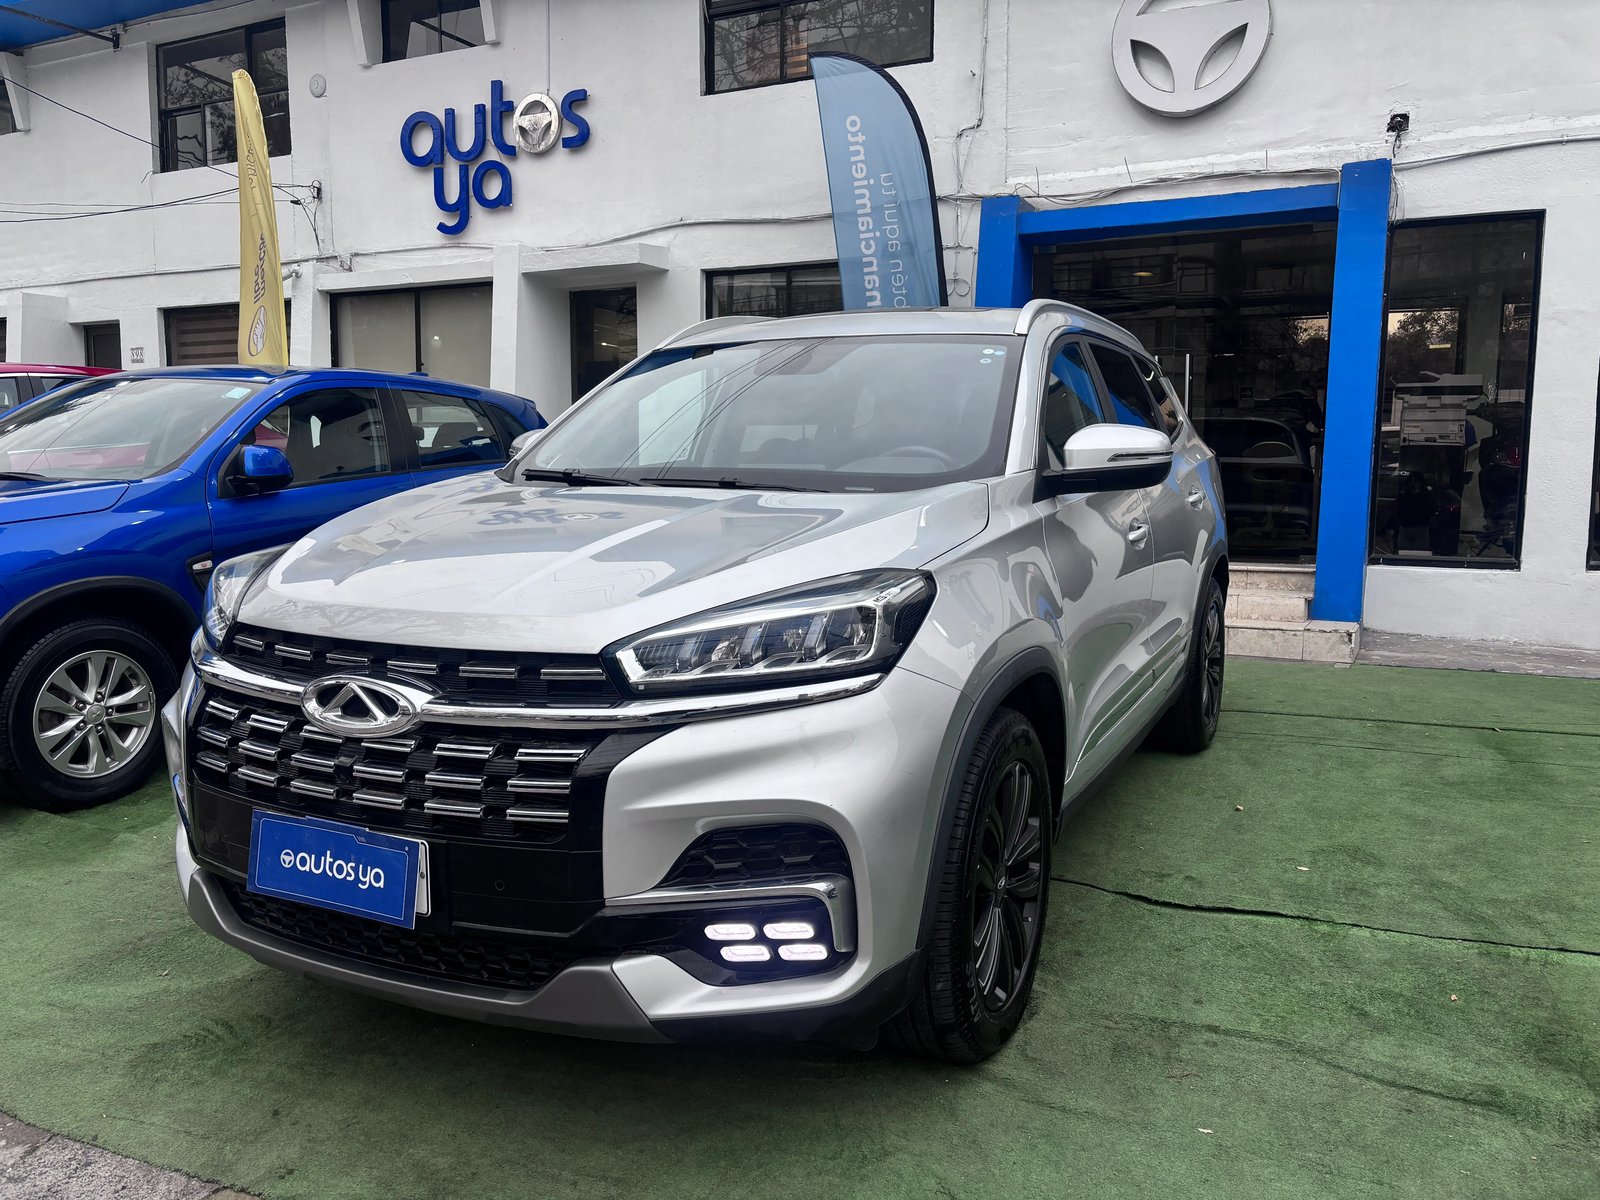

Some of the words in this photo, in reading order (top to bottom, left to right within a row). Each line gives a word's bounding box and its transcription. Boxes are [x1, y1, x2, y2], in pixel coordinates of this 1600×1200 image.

[400, 80, 590, 167] autos
[433, 160, 513, 235] ya
[296, 850, 356, 881] autos
[358, 864, 385, 889] ya
